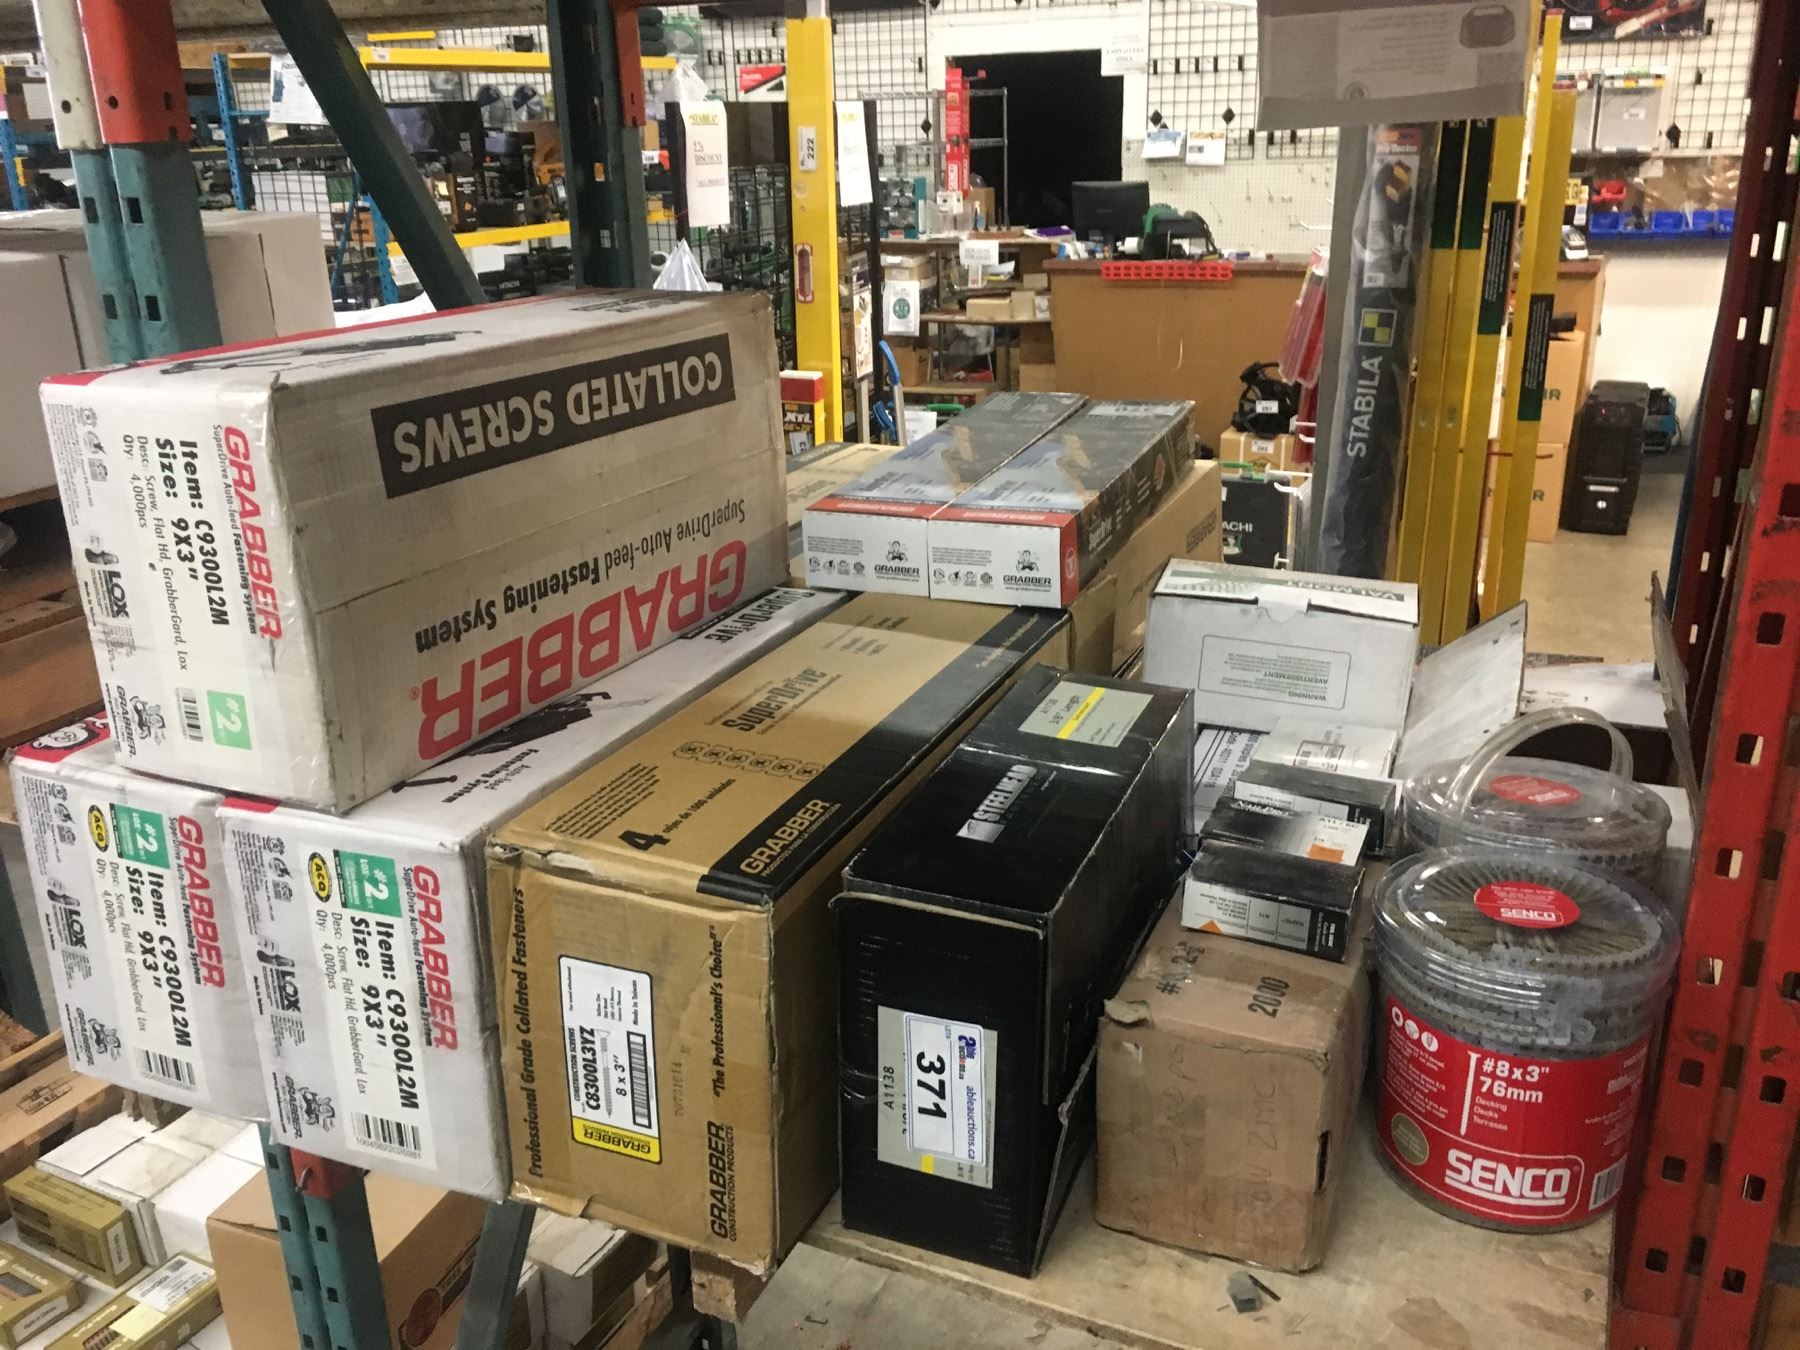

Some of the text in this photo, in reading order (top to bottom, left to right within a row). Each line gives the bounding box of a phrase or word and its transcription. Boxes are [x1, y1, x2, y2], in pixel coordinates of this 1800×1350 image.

[806, 136, 816, 160] 222
[394, 351, 723, 473] COLLATED SCREWS
[1347, 355, 1383, 458] STABILA
[156, 438, 178, 499] Size:
[180, 440, 230, 626] Item: C9300L2M
[212, 424, 230, 486] SuperDrive
[232, 532, 250, 591] Fastening
[242, 590, 257, 635] System
[224, 425, 283, 640] GRABBER
[1222, 520, 1253, 533] ACHI
[105, 569, 130, 619] LOX
[153, 517, 165, 541] Flat
[177, 650, 188, 671] Lox
[414, 499, 746, 654] SuperDrive Auto-feed Fastening System
[874, 564, 920, 575] GRABBER
[1003, 574, 1052, 585] GRABBER
[418, 539, 747, 761] GRABBER
[1288, 691, 1326, 701] WARNING
[618, 829, 670, 851] 4
[740, 799, 830, 874] GRABBER
[126, 865, 145, 916] Size:
[169, 816, 182, 863] SuperDrive
[183, 903, 196, 949] Fastening
[190, 950, 201, 985] System
[178, 815, 225, 988] GRABBER
[314, 861, 327, 893] ACQ
[403, 867, 415, 914] SuperDrive
[350, 915, 372, 969] Size:
[1500, 907, 1557, 922] SENCO
[148, 870, 192, 1047] Item: C9300L2M
[413, 864, 458, 1051] GRABBER
[414, 958, 429, 1010] Fastening
[281, 969, 302, 1013] LOX
[375, 920, 420, 1110] Item: C9300L2M
[1248, 976, 1290, 1018] 2000
[341, 977, 354, 997] Flat
[356, 1077, 367, 1095] Lox
[421, 1009, 433, 1047] System
[511, 887, 544, 1178] Professional Grade Collated Fasteners
[709, 981, 725, 1067] Professional's
[568, 1027, 581, 1102] CONSTRUCTION SCREWS
[578, 1025, 601, 1112] C8300L3YZ
[616, 1087, 627, 1097] 8
[617, 1077, 627, 1087] x
[883, 1066, 895, 1110] A1138
[916, 1051, 947, 1119] 371
[1479, 1076, 1543, 1104] 76mm
[966, 1085, 977, 1160] ableauctions.ca
[1473, 1106, 1499, 1119] Decks
[1475, 1096, 1508, 1112] Decking
[583, 1129, 652, 1155] GRABBER
[707, 1120, 728, 1240] GRABBER
[726, 1126, 737, 1242] CONSTRUCTION PRODUCTS
[1448, 1149, 1571, 1199] SENCO
